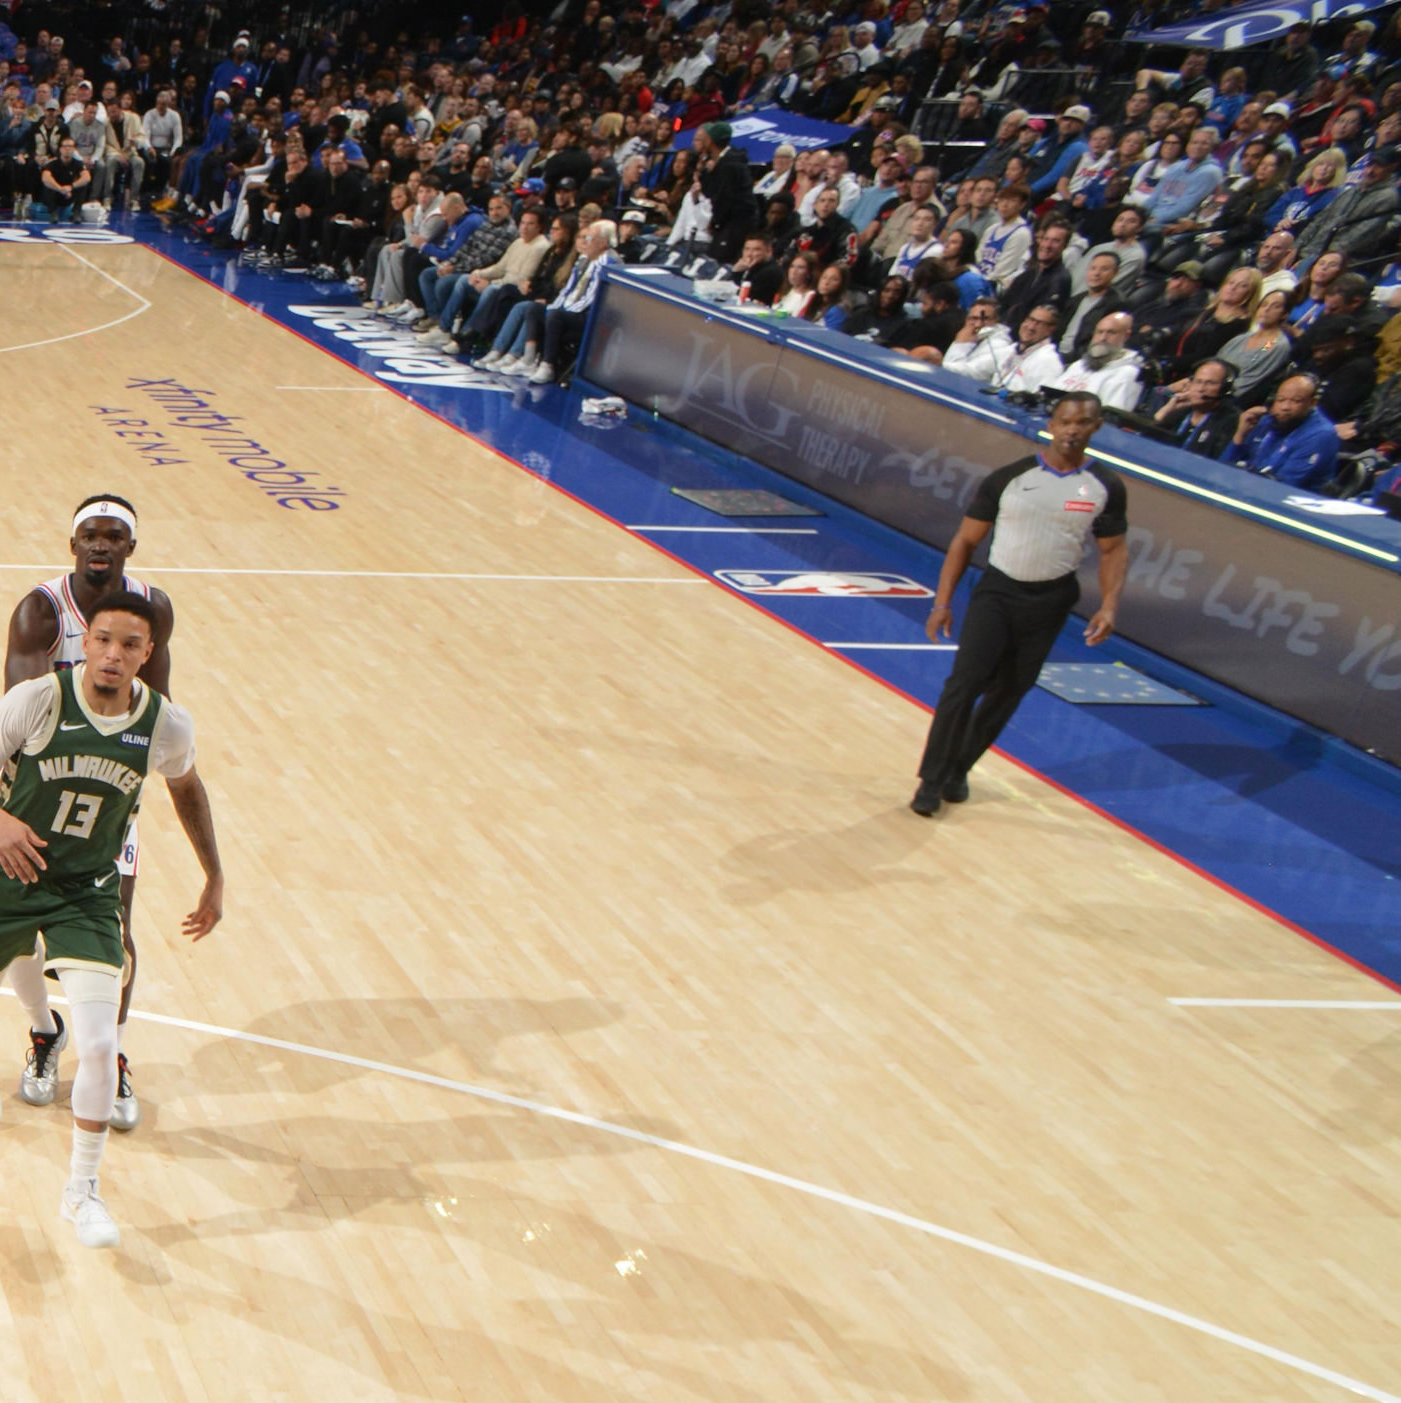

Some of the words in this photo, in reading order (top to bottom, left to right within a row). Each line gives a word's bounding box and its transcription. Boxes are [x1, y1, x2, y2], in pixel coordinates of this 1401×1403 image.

[647, 331, 803, 437] JAG
[807, 380, 886, 440] PHYSICAL
[88, 405, 190, 467] ARENA
[797, 425, 872, 485] THERAPY
[201, 437, 348, 512] mobile
[1201, 562, 1342, 657] LIFE
[122, 733, 150, 746] ULINE
[50, 790, 104, 840] 13
